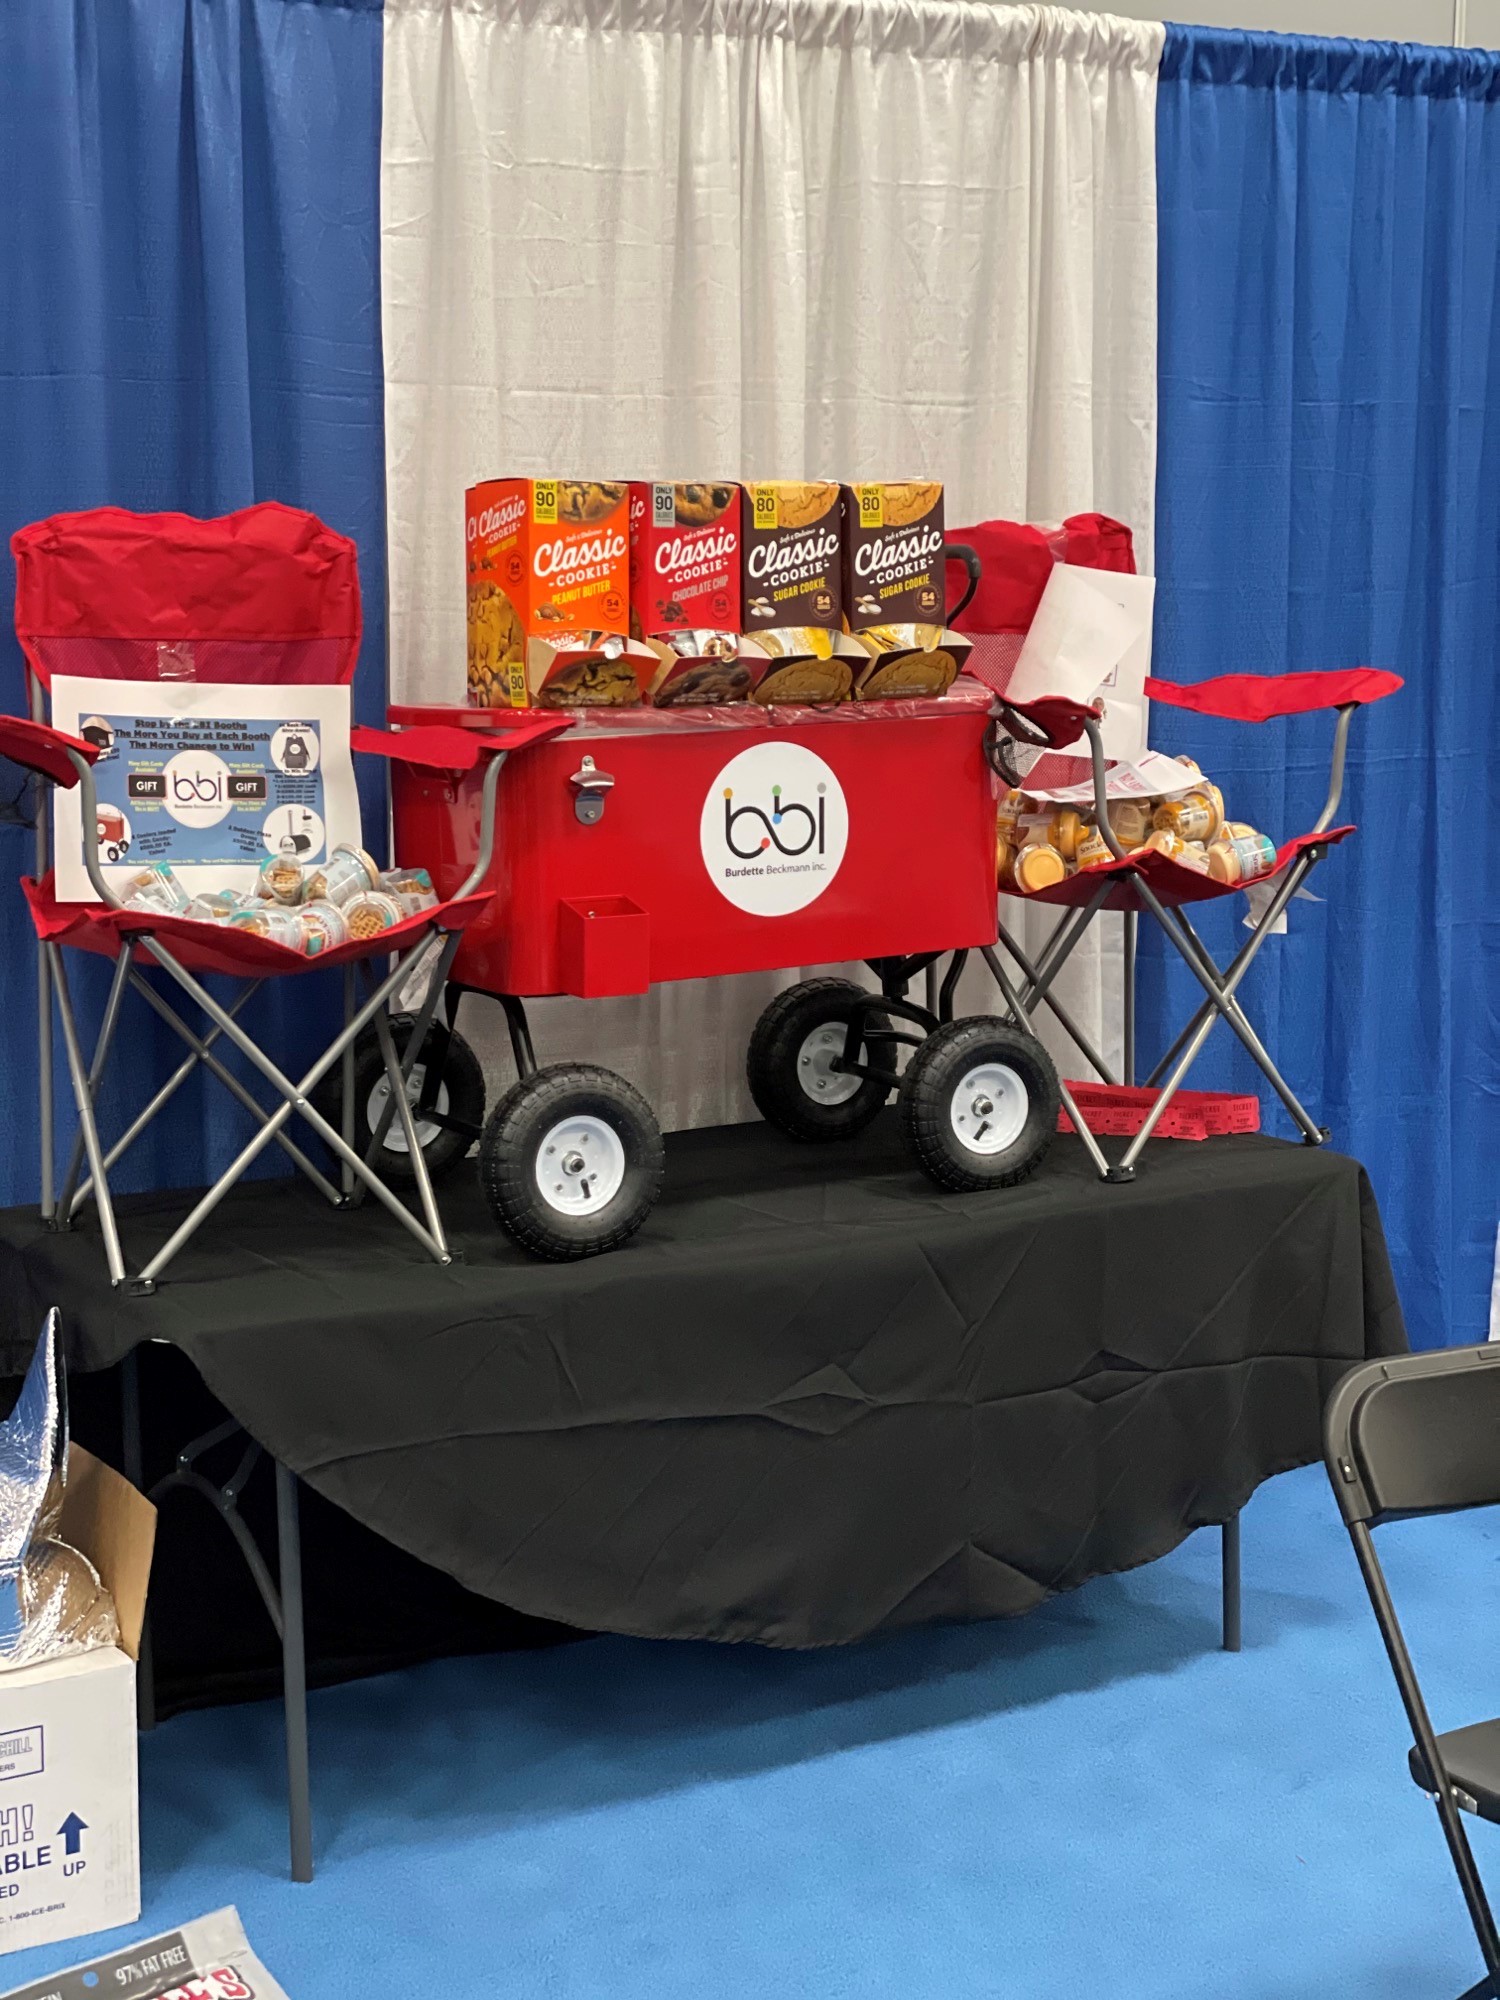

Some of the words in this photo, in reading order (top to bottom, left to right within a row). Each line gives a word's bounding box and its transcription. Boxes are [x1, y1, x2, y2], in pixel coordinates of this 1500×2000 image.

[536, 482, 555, 490] ONLY
[656, 486, 673, 494] ONLY
[757, 488, 774, 496] ONLY
[862, 487, 879, 495] ONLY
[536, 491, 555, 507] 90
[656, 495, 673, 510] 90
[757, 497, 774, 512] 80
[862, 496, 879, 511] 80
[479, 494, 526, 538] Classic
[533, 528, 626, 577] Classic
[655, 526, 737, 574] Classic
[748, 527, 839, 578] Classic
[855, 525, 943, 576] Classic
[552, 587, 581, 605] PEANUT
[582, 579, 611, 598] BUTTER
[672, 580, 712, 602] CHOCOLATE
[712, 575, 729, 590] CHIP
[773, 585, 799, 602] SUGAR
[799, 577, 826, 594] COOKIE
[879, 582, 903, 599] SUGAR
[904, 573, 930, 591] COOKIE
[607, 599, 619, 607] 54
[817, 596, 830, 604] 54
[921, 592, 935, 600] 54
[510, 675, 524, 689] 90
[135, 719, 157, 728] Stop
[214, 721, 247, 730] Booths
[114, 729, 131, 738] The
[160, 731, 180, 739] You
[182, 731, 200, 740] Buy
[216, 732, 239, 740] Each
[242, 732, 271, 741] Booth
[129, 741, 146, 749] The
[150, 741, 174, 749] More
[177, 742, 217, 750] Chances
[232, 743, 255, 751] Win!
[136, 781, 158, 791] GIFT
[235, 782, 258, 792] GIFT
[723, 782, 827, 859] bbi
[725, 866, 764, 878] Burdette
[766, 863, 811, 875] Beckmann
[812, 862, 827, 871] inc.
[1233, 1103, 1252, 1111] TICKET
[63, 1860, 86, 1877] UP
[9, 1902, 66, 1921] 1-800-ICE-BRIX
[115, 1962, 142, 1986] 97%
[141, 1955, 161, 1976] FAT
[160, 1945, 188, 1969] FREE
